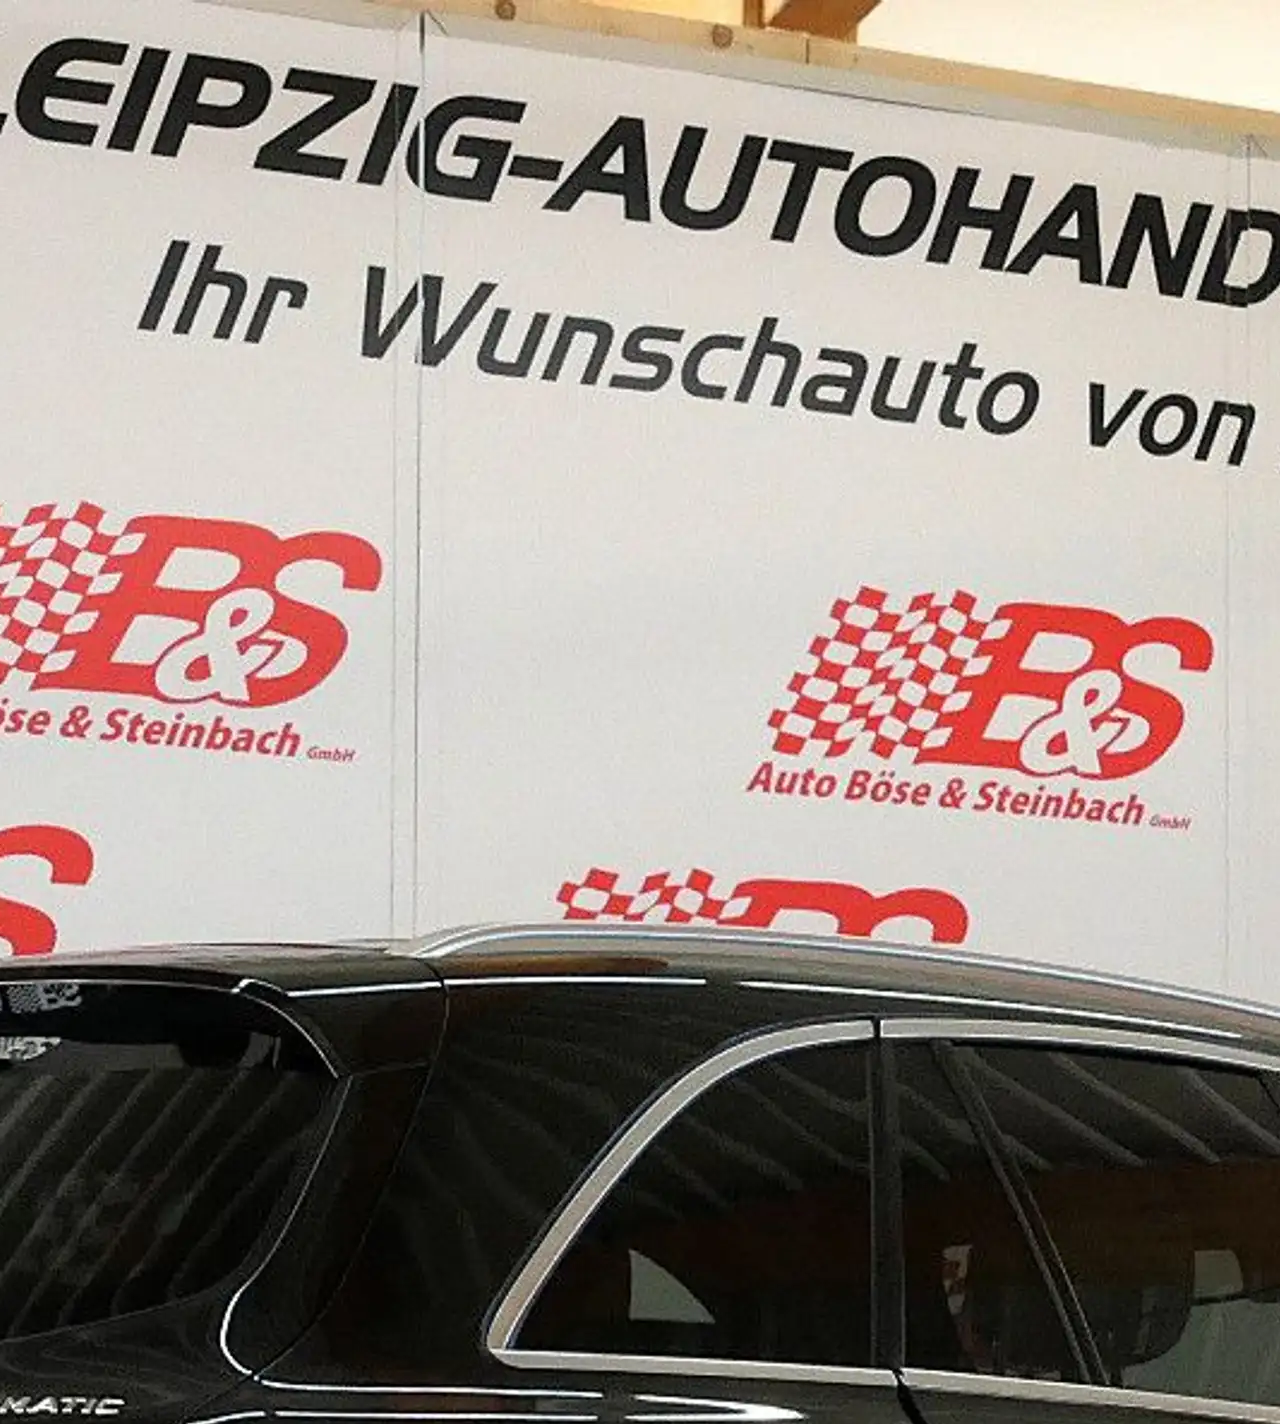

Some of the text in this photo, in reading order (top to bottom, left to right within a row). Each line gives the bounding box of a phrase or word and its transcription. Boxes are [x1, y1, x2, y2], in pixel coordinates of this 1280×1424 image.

[138, 240, 308, 344] Ihr
[361, 266, 1041, 435] Wunschauto
[1090, 383, 1255, 466] von
[31, 516, 382, 706] B&S
[913, 603, 1212, 780] B&S
[59, 704, 93, 740] &
[100, 708, 302, 757] Steinbach
[305, 741, 357, 763] GmbH
[746, 760, 840, 800] Auto
[844, 768, 933, 807] Böse
[939, 777, 967, 809] &
[973, 779, 1148, 824] Steinbach
